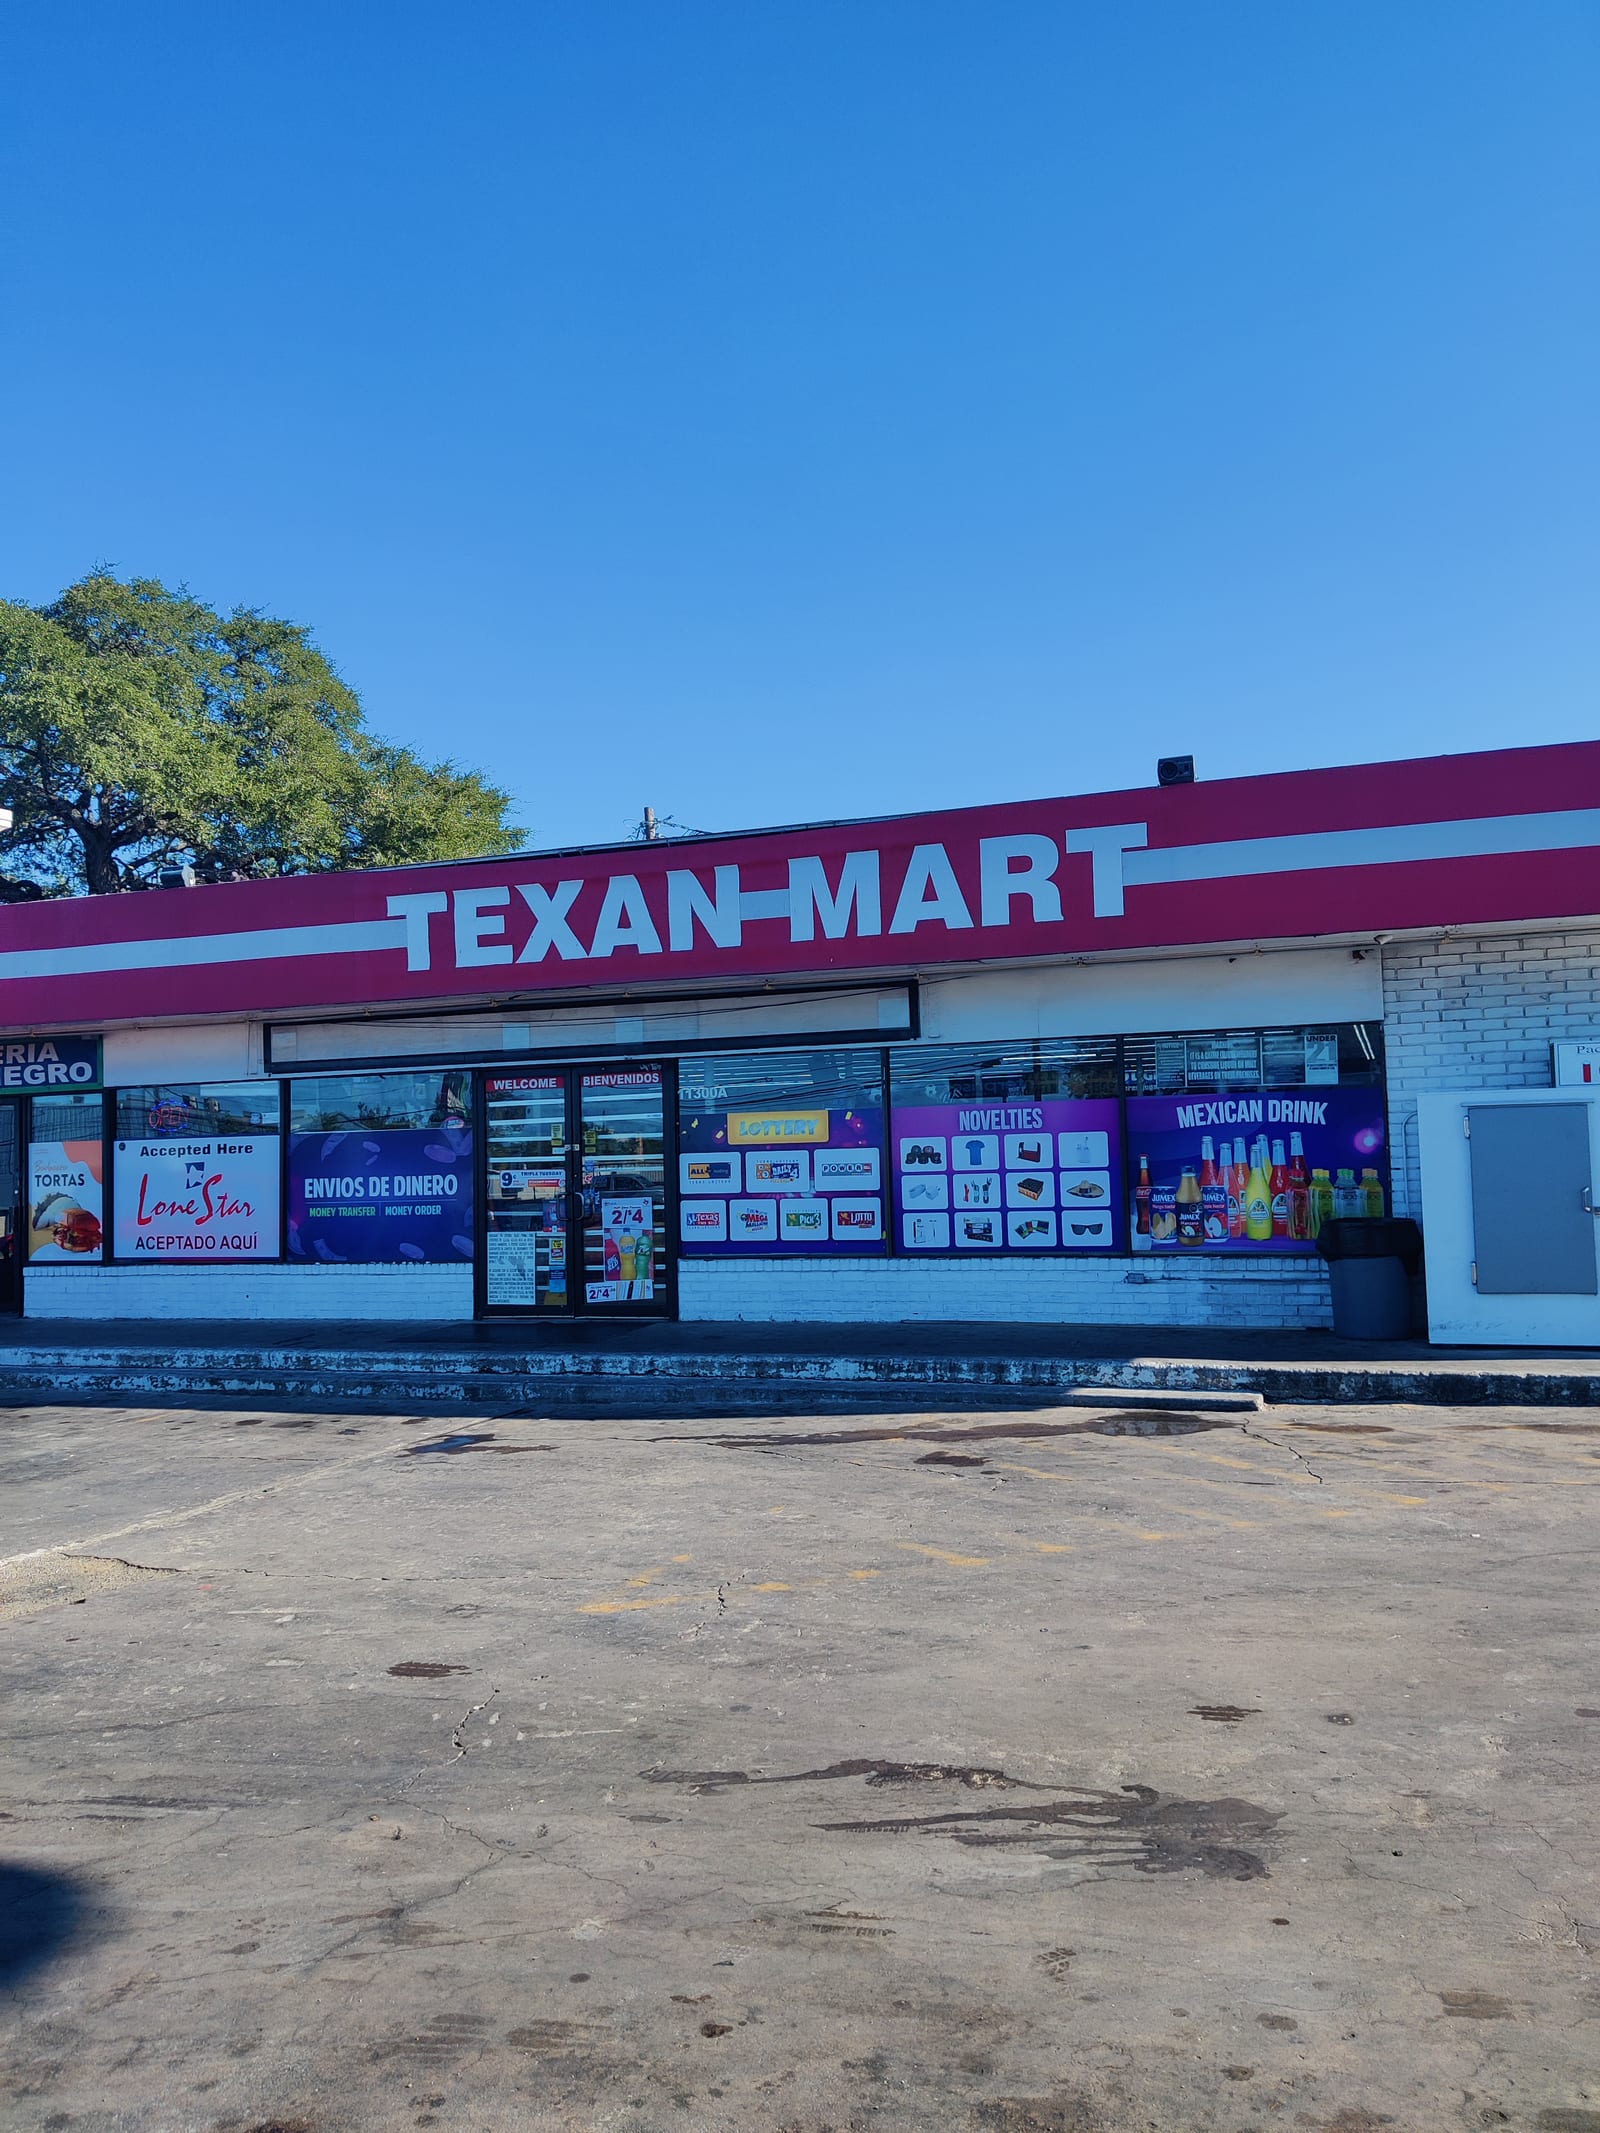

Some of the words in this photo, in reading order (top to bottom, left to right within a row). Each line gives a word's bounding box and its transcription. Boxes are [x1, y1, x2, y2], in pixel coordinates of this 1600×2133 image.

[386, 864, 742, 971] TEXAN
[788, 822, 1148, 943] MART
[0, 1062, 92, 1087] EGRO
[583, 1073, 660, 1087] BIENVENIDOS
[493, 1078, 557, 1090] WELCOME
[677, 1087, 728, 1099] 11300A
[149, 1107, 189, 1127] OPEN
[959, 1108, 1043, 1131] NOVELTIES
[1176, 1100, 1263, 1129] MEXICAN
[1268, 1100, 1328, 1125] DRINK
[739, 1119, 820, 1136] LOTTERY
[140, 1144, 211, 1157] Accepted
[217, 1143, 254, 1155] Here
[34, 1173, 85, 1188] TORTAS
[304, 1176, 364, 1198] ENVIOS
[369, 1176, 389, 1197] DE
[394, 1174, 458, 1196] DINERO
[1152, 1193, 1176, 1202] JUMEX
[309, 1207, 336, 1217] MONEY
[338, 1206, 376, 1217] TRANSFER
[385, 1206, 413, 1216] MONEY
[415, 1205, 442, 1215] ORDER
[799, 1214, 814, 1225] PICK
[850, 1212, 873, 1224] LOTTO
[136, 1235, 216, 1251] ACEPTADO
[220, 1231, 258, 1251] AQUÍ
